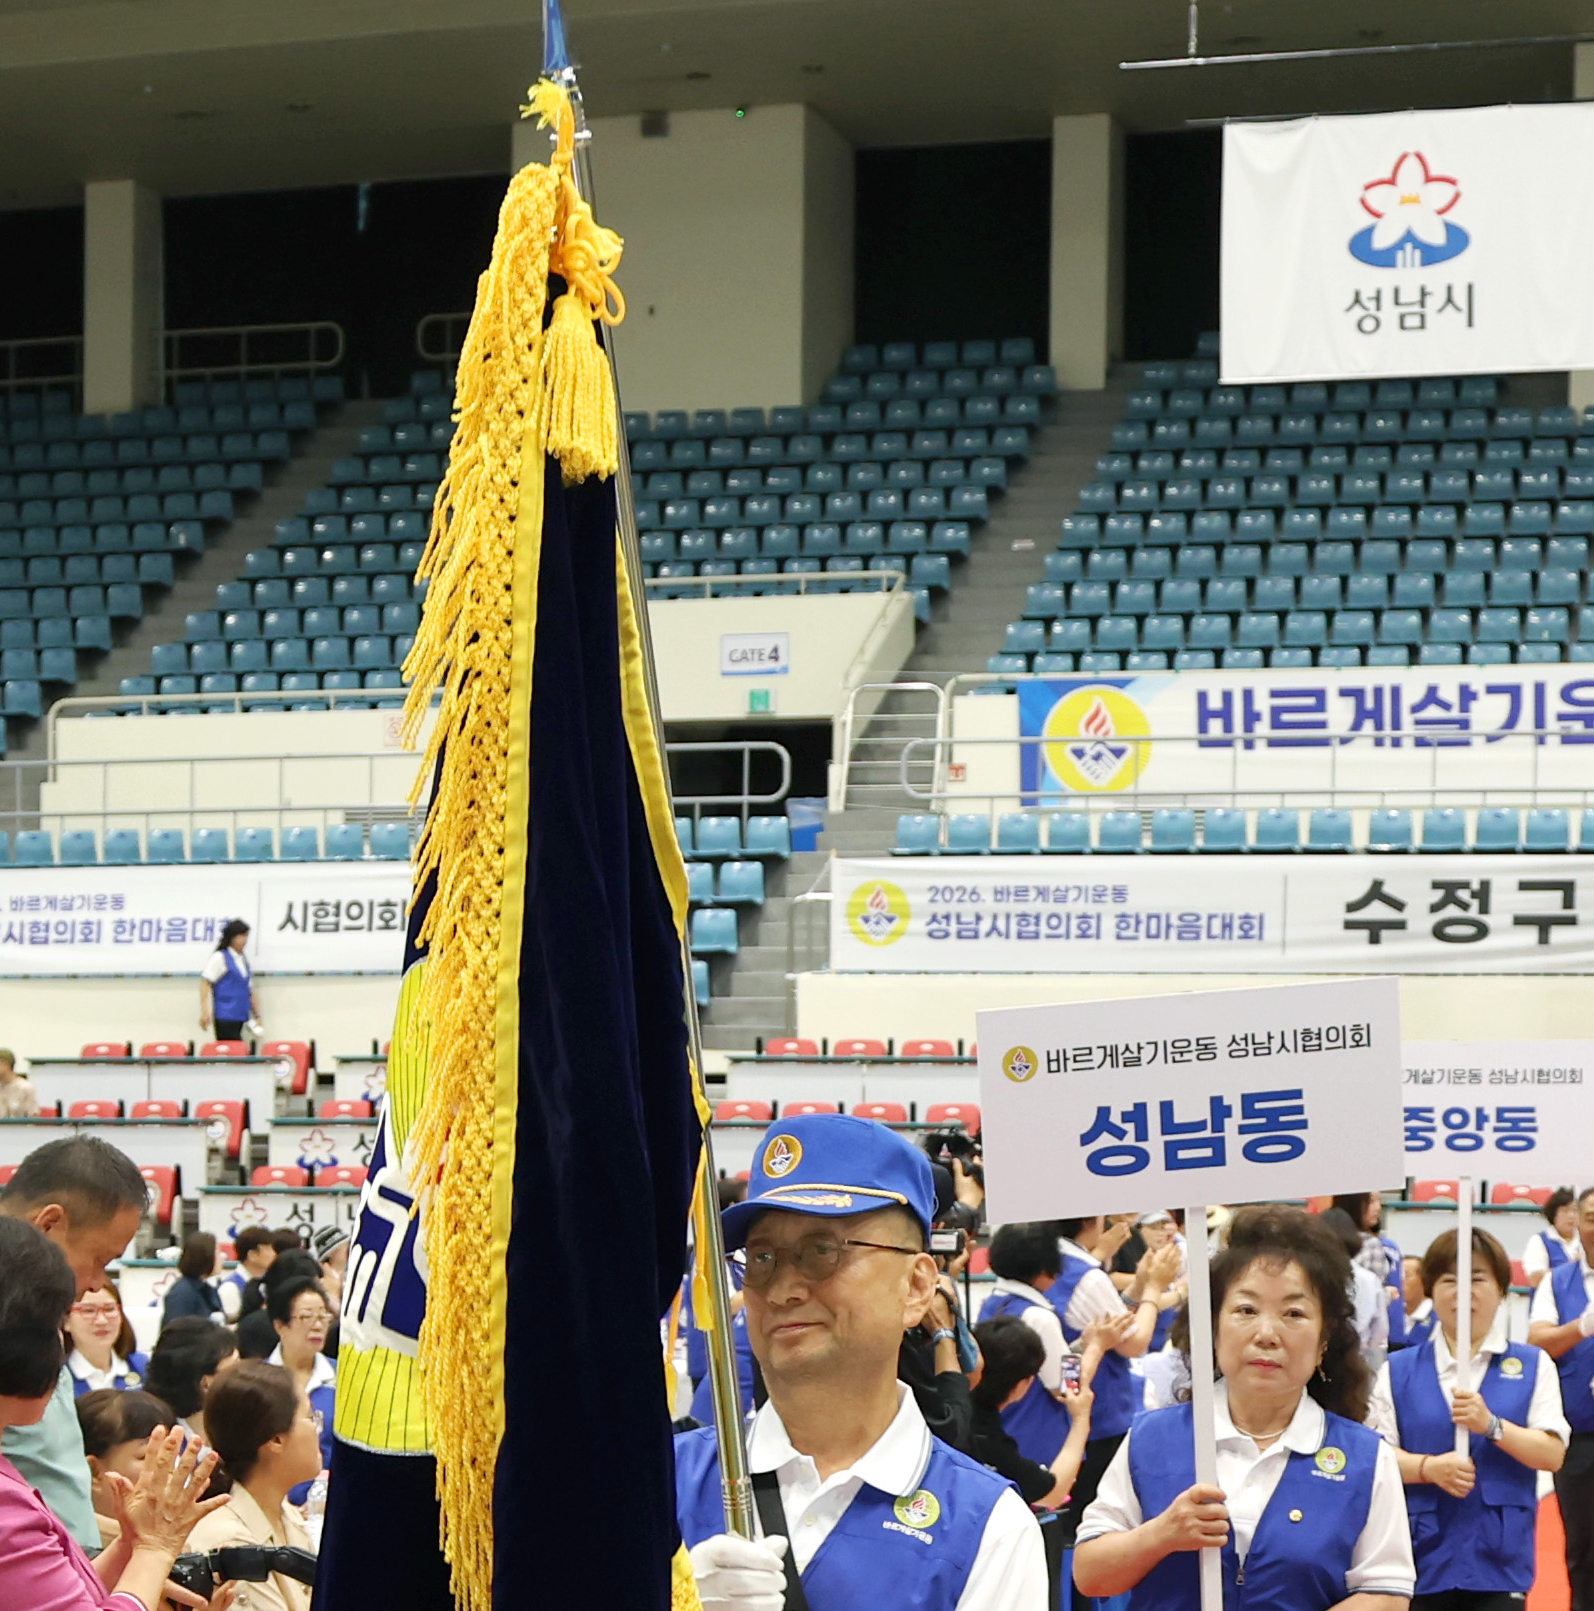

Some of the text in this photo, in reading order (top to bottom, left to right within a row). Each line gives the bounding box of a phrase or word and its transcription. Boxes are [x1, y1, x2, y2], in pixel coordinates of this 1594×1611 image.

[1344, 281, 1474, 335] 성남시
[728, 643, 780, 663] GATE 4
[8, 892, 125, 913] 바르게살기운동
[926, 884, 1130, 905] 2026. 바르게살기운동
[1343, 878, 1579, 945] 수정구
[276, 899, 406, 934] 시협의회
[924, 910, 1266, 943] 성남시협의회 한마음대회
[1046, 1022, 1372, 1074] 바르게살기운동 성남시협의회
[1401, 1067, 1584, 1085] 게살기운동 성남시협의회
[1079, 1087, 1309, 1177] 성남동
[1403, 1105, 1539, 1153] 중앙동
